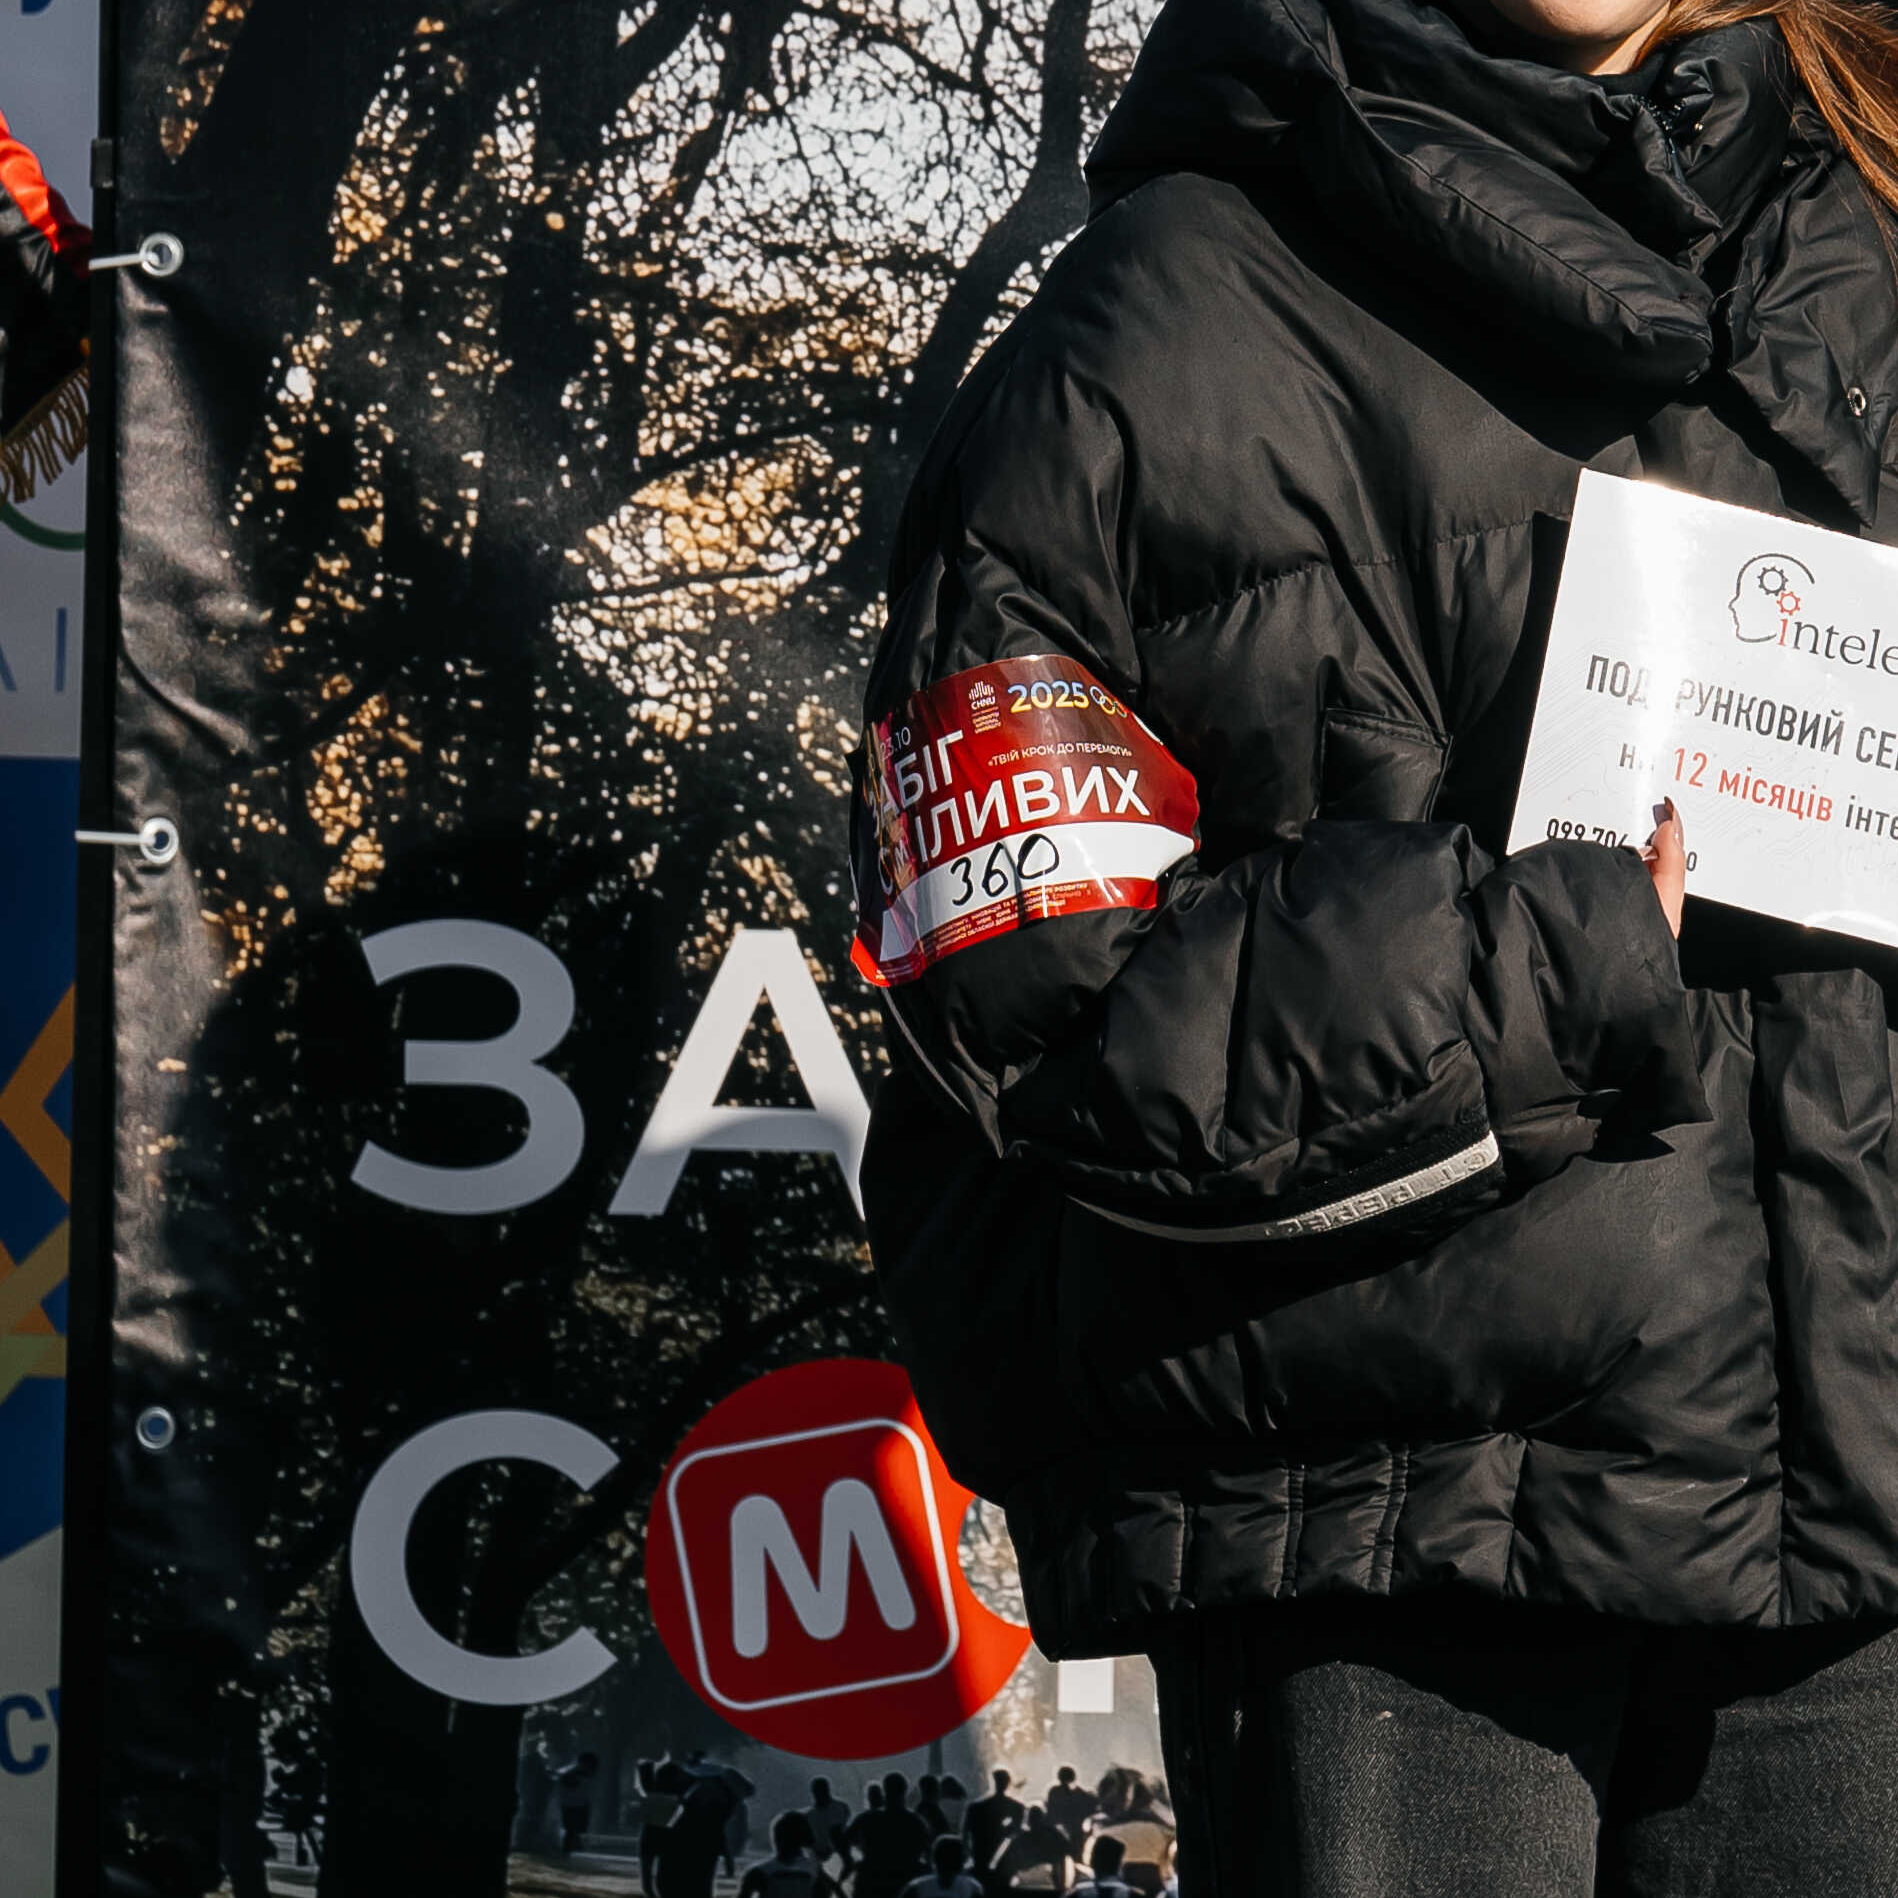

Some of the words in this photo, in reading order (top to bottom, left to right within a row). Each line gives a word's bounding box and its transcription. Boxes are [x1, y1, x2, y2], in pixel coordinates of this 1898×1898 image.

[1007, 680, 1089, 714] 2025
[1586, 654, 1845, 756] ПОДРУНКОВИЙ
[1021, 744, 1056, 759] КРОК
[1056, 742, 1075, 755] ДО
[1673, 747, 1708, 787] 12
[1718, 767, 1834, 822] місяців
[950, 833, 1061, 906] 360
